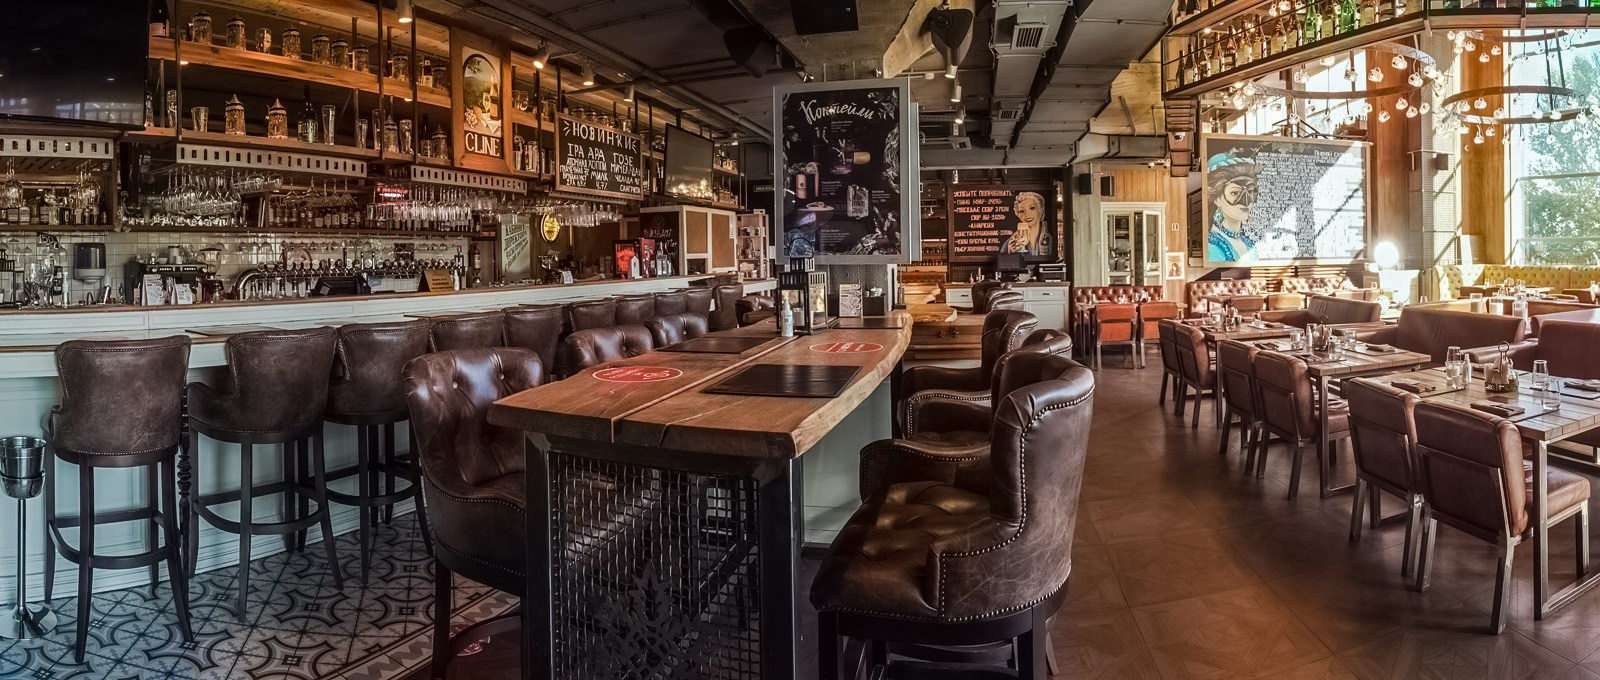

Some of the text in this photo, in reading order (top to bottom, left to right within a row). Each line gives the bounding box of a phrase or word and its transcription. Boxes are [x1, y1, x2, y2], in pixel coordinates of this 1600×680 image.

[799, 99, 875, 125] Коктейли
[465, 132, 500, 157] CLINE
[572, 121, 632, 150] НОВИНКИ
[613, 152, 633, 167] ГОЗЕ
[591, 171, 608, 182] МИЛК
